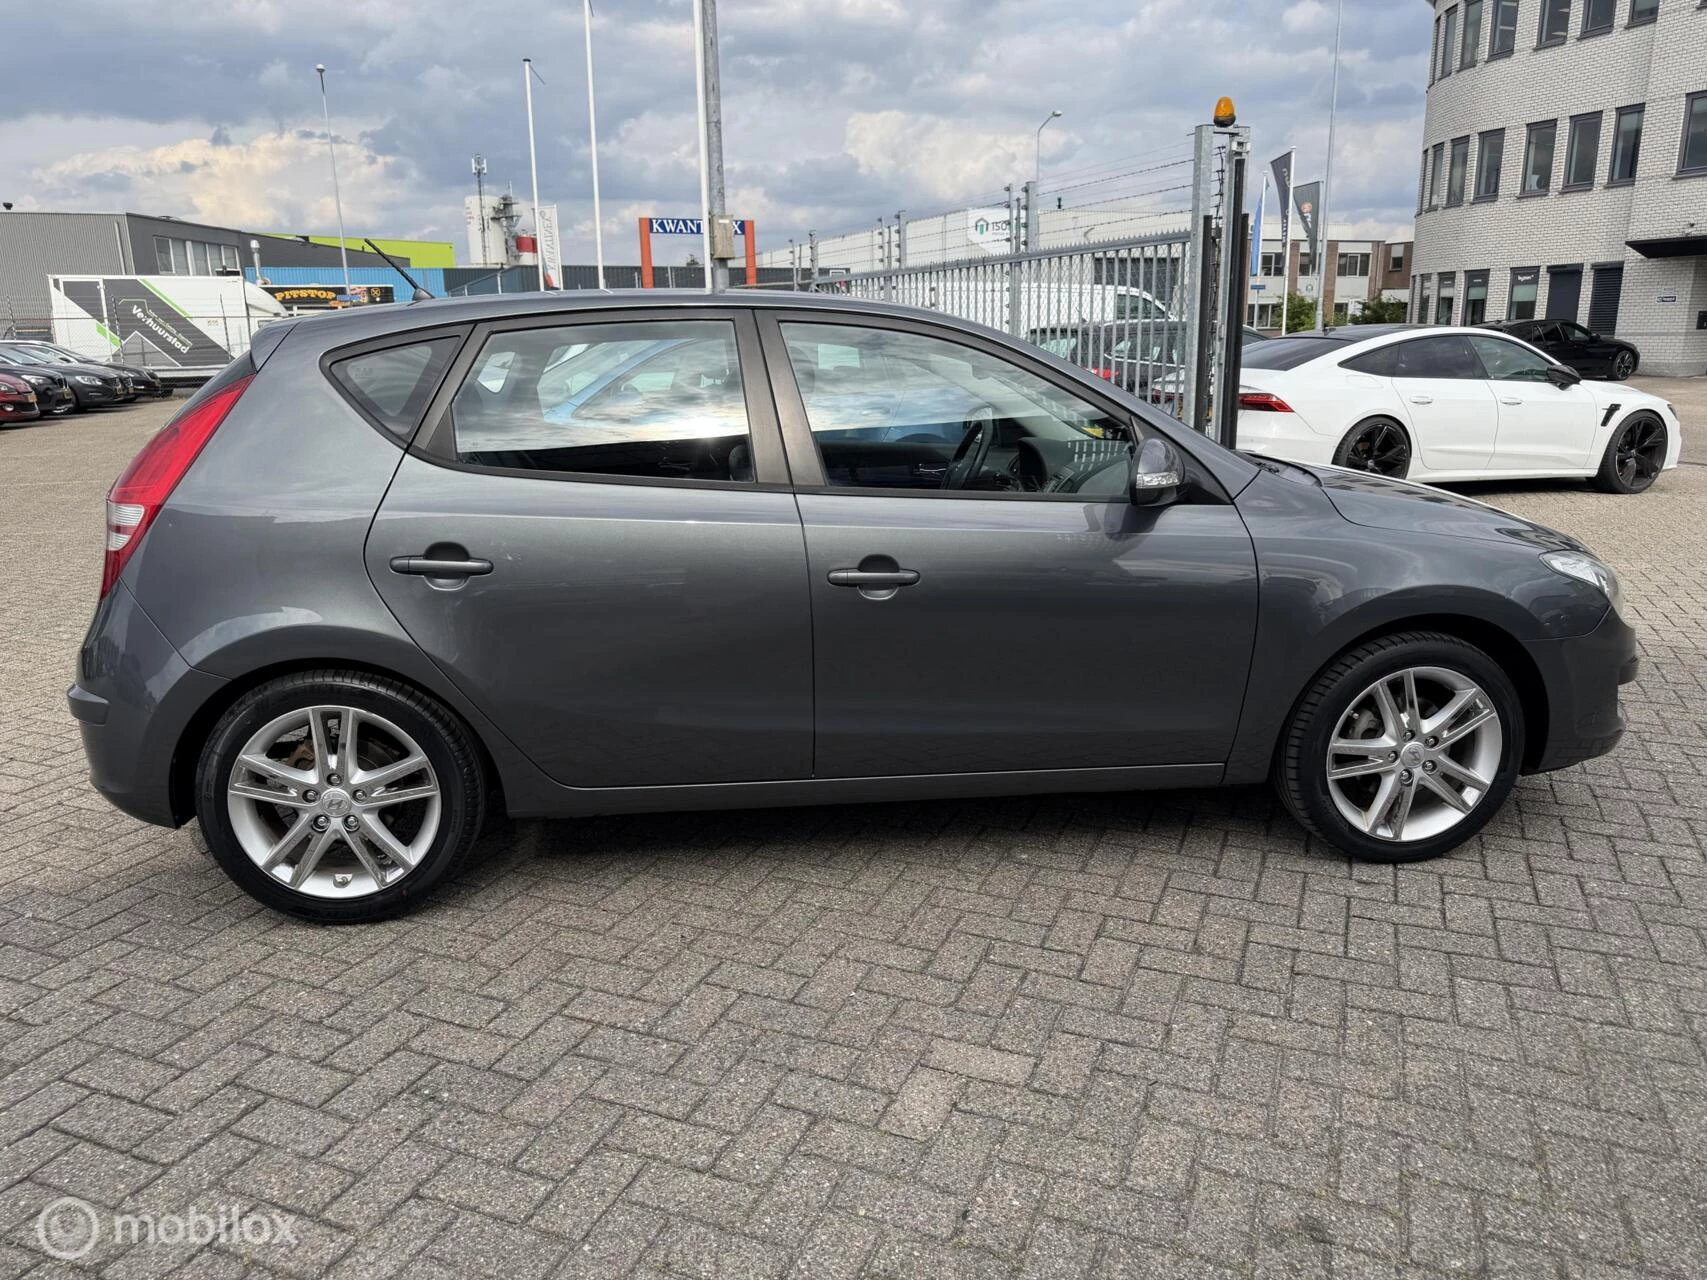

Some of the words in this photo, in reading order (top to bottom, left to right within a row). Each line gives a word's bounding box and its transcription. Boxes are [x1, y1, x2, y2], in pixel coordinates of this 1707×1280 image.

[652, 219, 742, 234] KWANTX
[275, 289, 336, 301] PITSTOP
[132, 305, 190, 353] Verhuurstad
